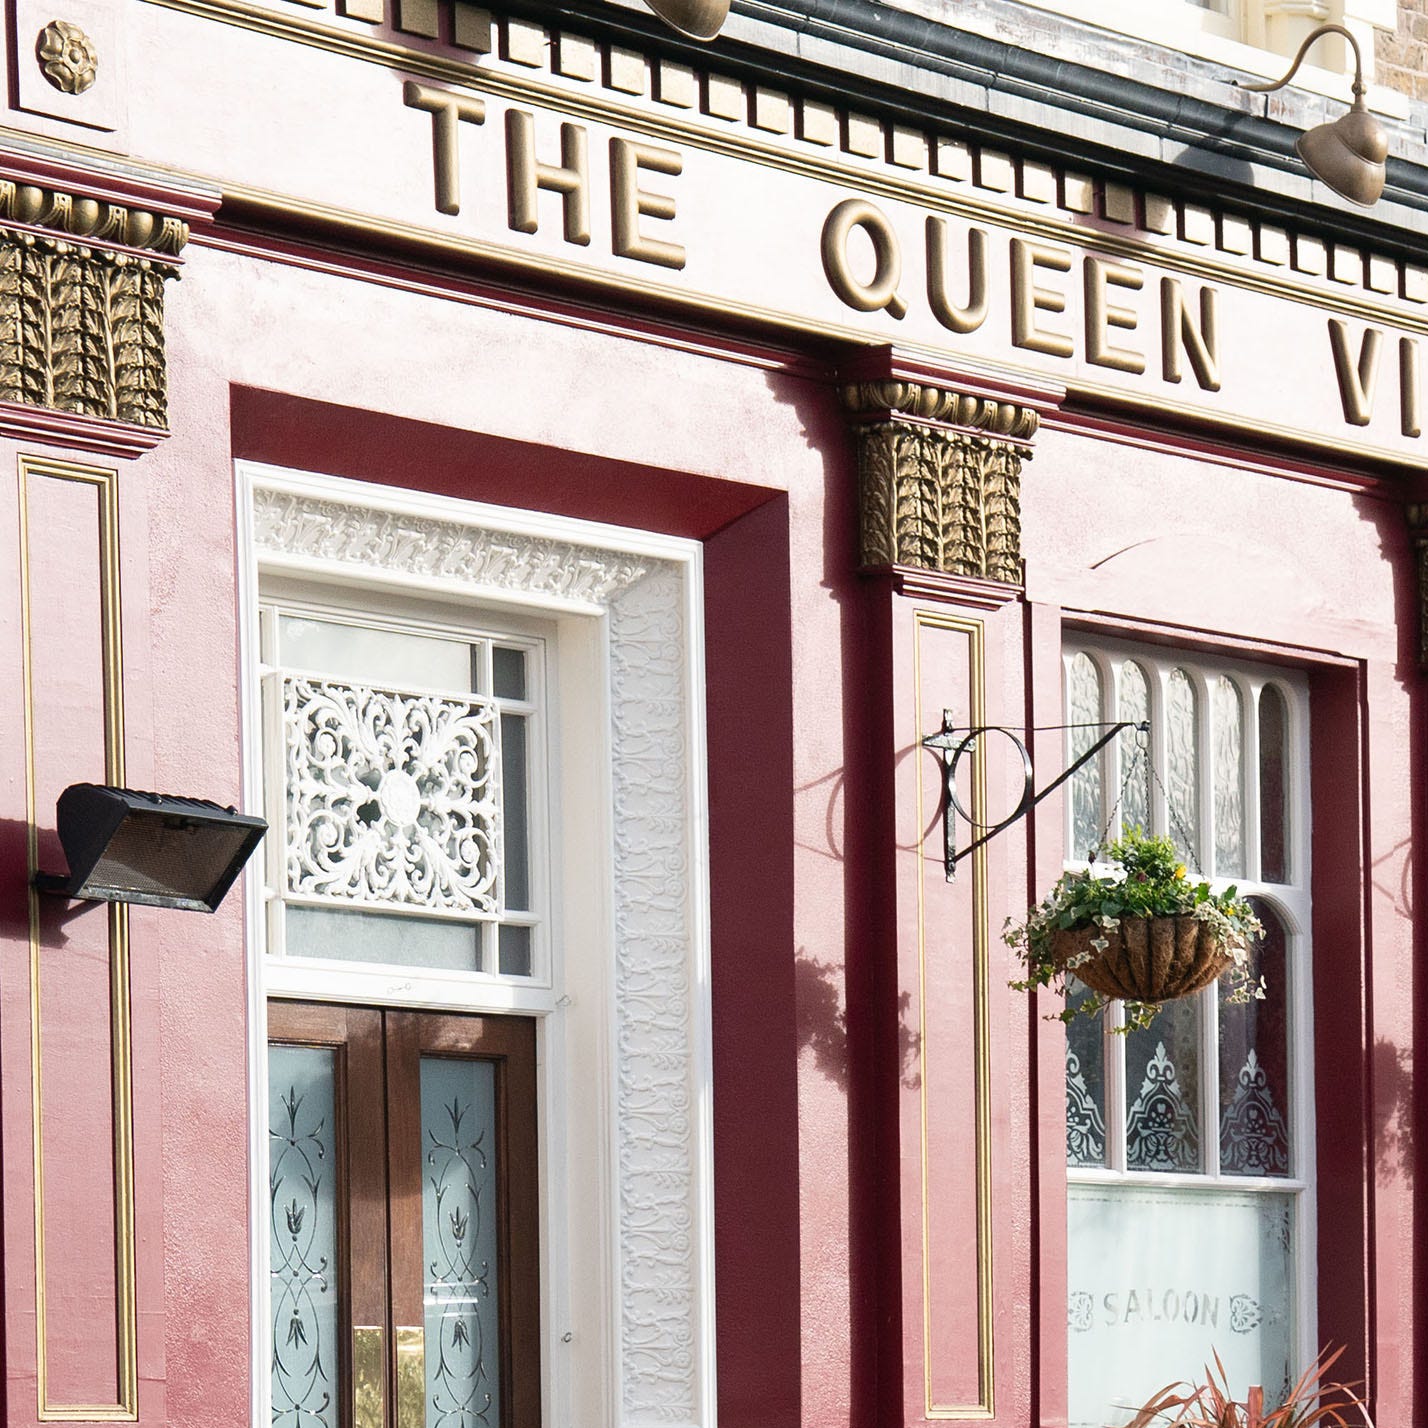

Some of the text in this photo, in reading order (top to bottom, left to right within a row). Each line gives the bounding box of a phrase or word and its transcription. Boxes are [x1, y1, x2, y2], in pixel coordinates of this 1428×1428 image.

[402, 80, 687, 270] THE
[820, 198, 1221, 393] QUEEN
[1103, 1288, 1219, 1329] SALOON
